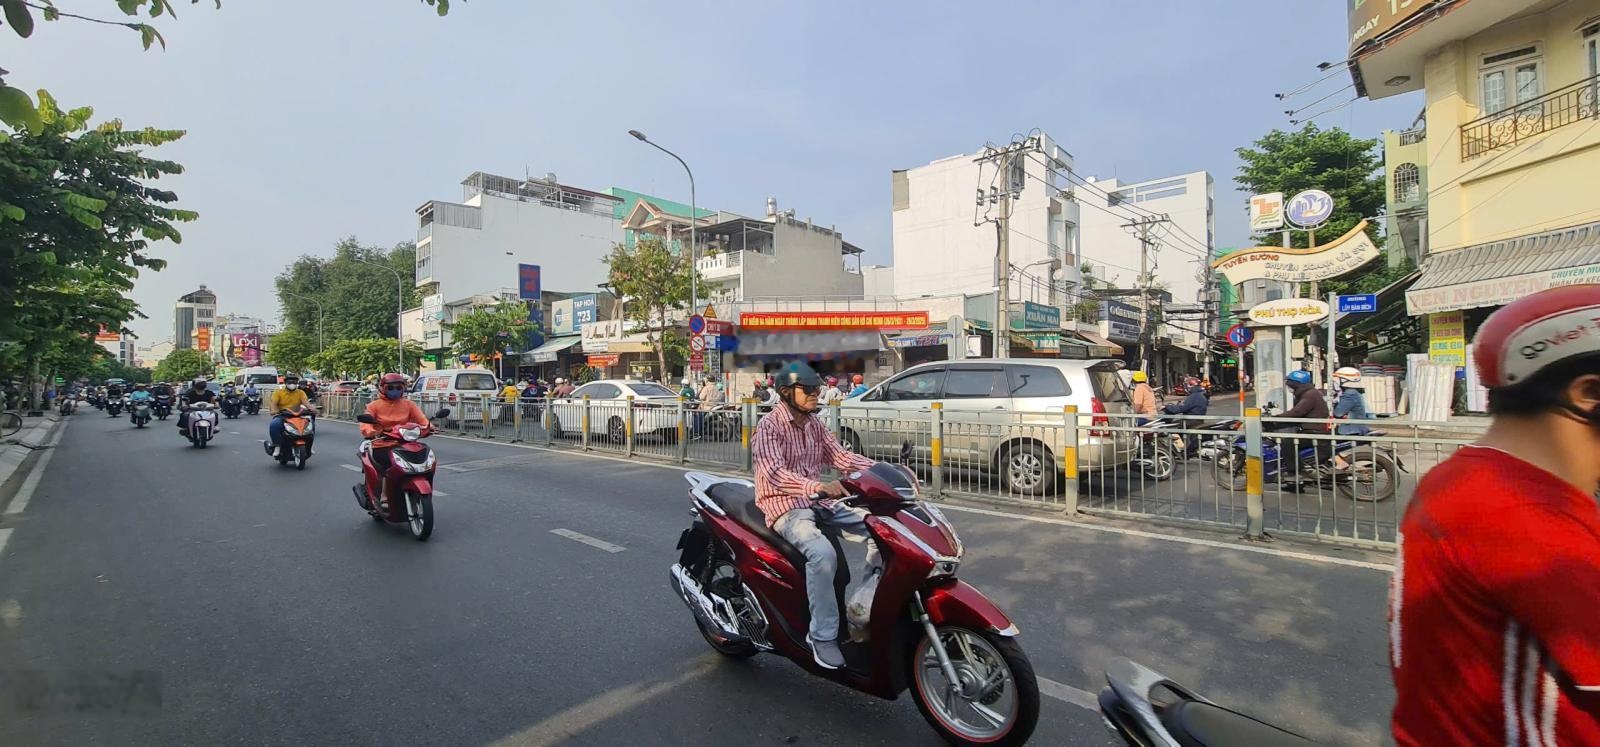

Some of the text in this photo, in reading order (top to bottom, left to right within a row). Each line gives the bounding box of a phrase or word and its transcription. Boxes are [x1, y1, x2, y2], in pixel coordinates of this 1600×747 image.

[577, 310, 591, 323] 723
[1254, 304, 1323, 319] PHÚ THỌ HÒA
